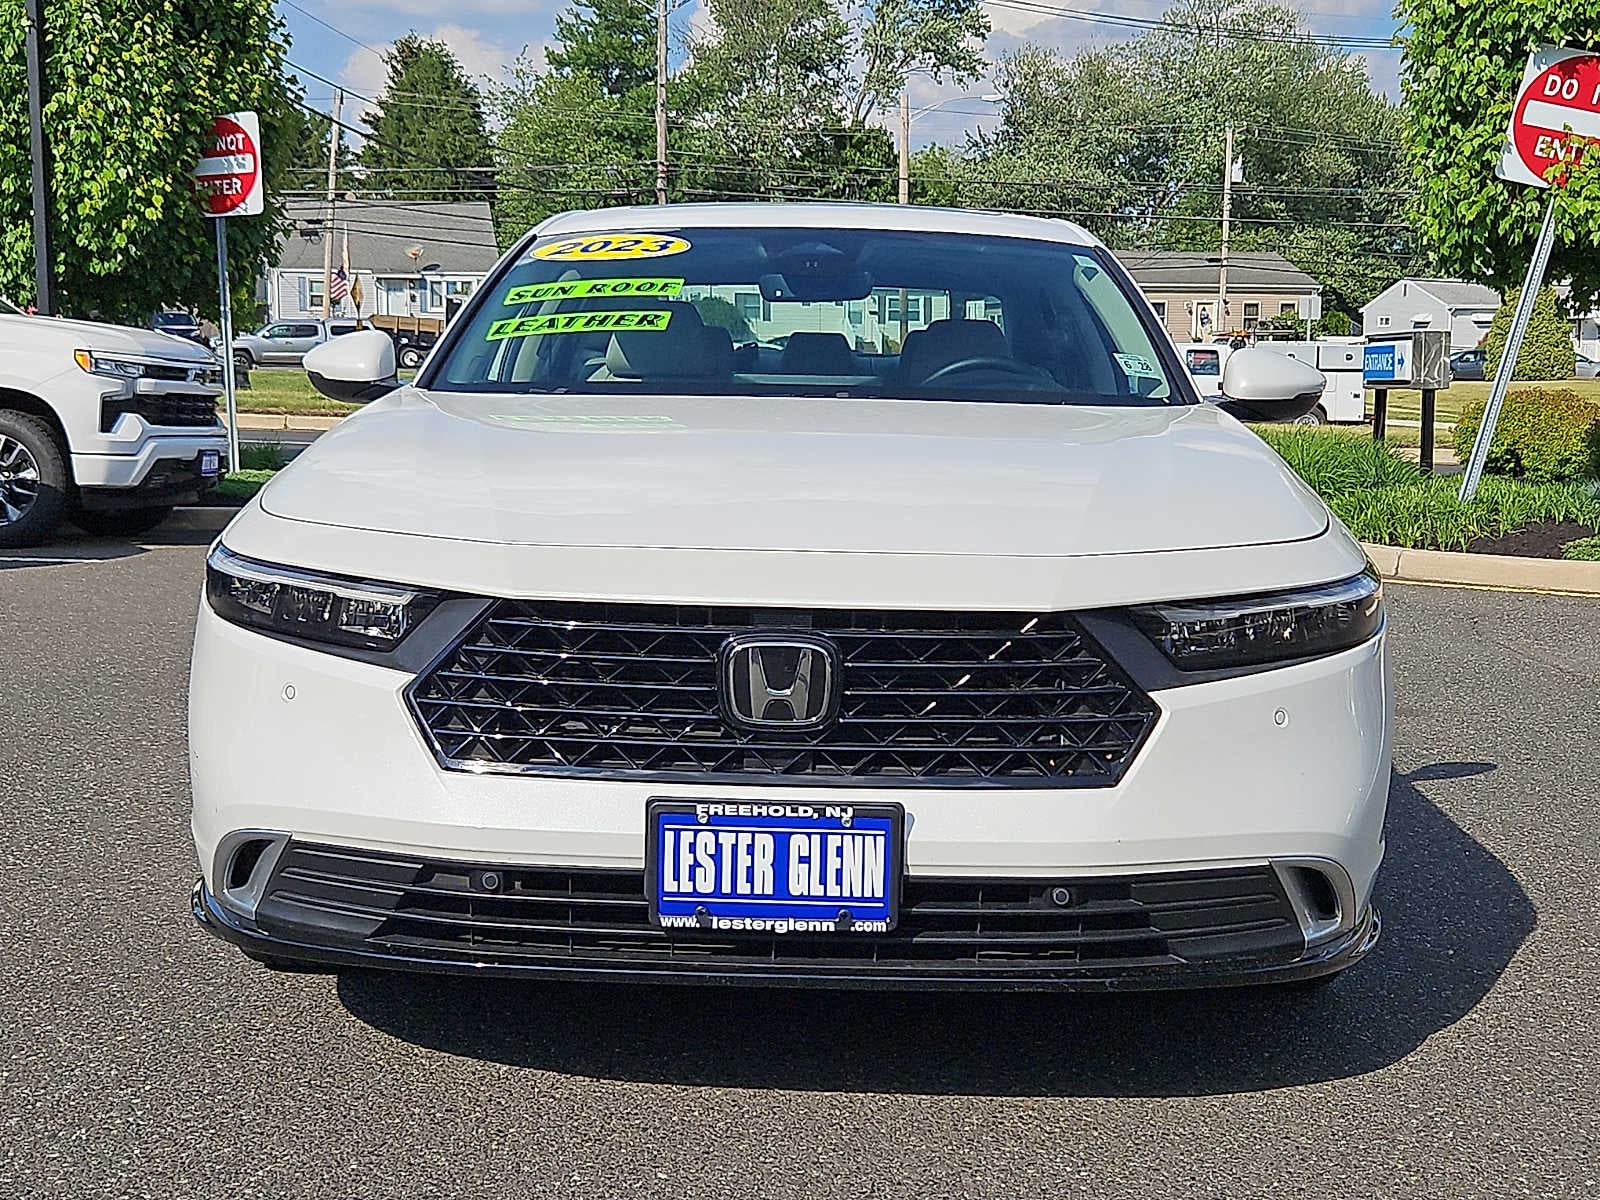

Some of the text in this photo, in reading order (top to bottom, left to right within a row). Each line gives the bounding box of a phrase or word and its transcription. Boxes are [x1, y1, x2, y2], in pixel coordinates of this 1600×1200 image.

[1543, 73, 1579, 100] DO
[216, 132, 246, 151] NOT
[546, 239, 675, 256] 2023
[509, 282, 682, 302] SUN ROOF
[491, 313, 666, 336] LEATHER
[696, 803, 854, 820] FREEHOLD, NJ
[663, 830, 885, 898] LESTER GLENN
